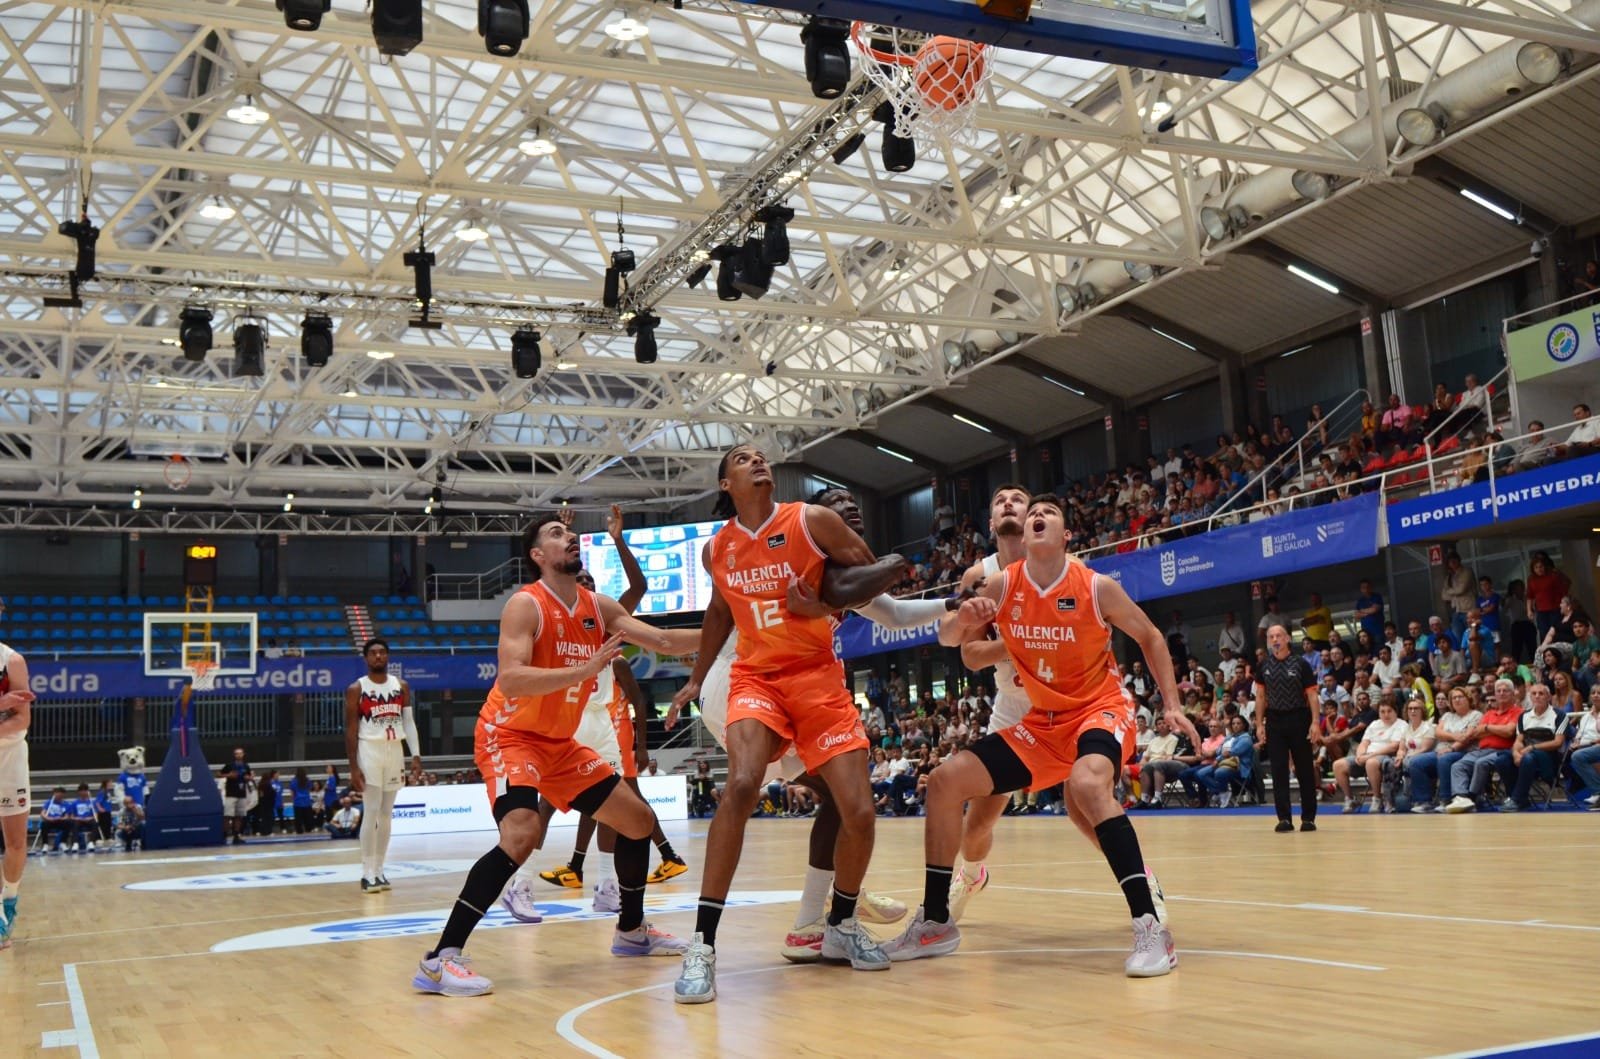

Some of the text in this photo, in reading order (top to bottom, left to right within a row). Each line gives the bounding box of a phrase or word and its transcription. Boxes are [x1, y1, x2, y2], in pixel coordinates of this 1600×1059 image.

[1401, 501, 1476, 528] DEPORTE
[1273, 532, 1296, 544] XUNTA
[1274, 538, 1311, 554] DE GALICIA
[726, 562, 793, 588] VALENCIA
[743, 581, 779, 594] BASKET
[750, 600, 784, 630] 12
[1009, 623, 1076, 642] VALENCIA
[1024, 641, 1059, 650] BASKET
[1037, 658, 1053, 683] 4
[566, 681, 583, 703] 2
[737, 697, 772, 711] PULEVA
[823, 732, 853, 748] Midea
[430, 805, 472, 815] AkzoNobel
